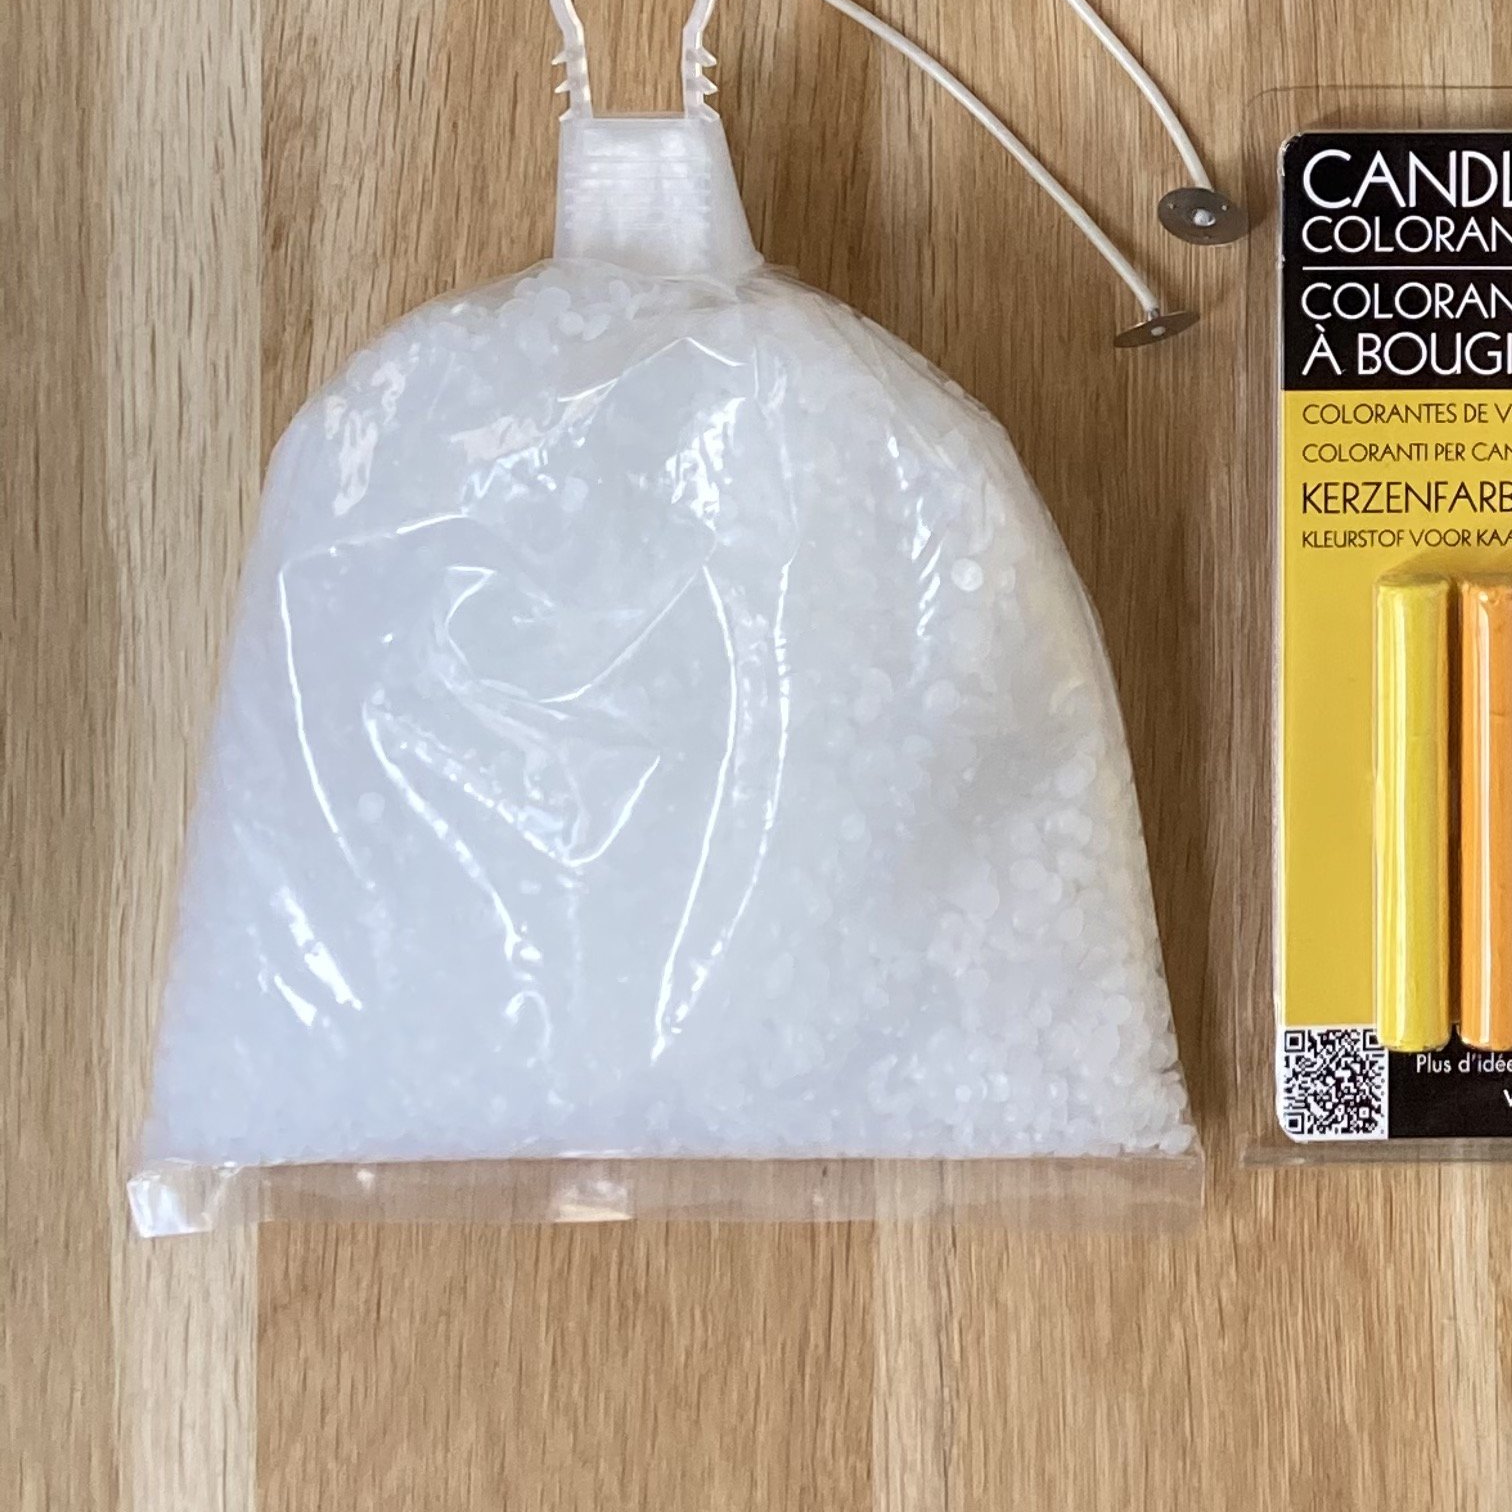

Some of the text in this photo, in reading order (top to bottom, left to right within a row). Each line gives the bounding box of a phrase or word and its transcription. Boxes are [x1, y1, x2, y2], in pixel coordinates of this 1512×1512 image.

[1301, 322, 1342, 376] À
[1302, 403, 1457, 425] COLORANTES
[1463, 403, 1489, 424] DE
[1302, 442, 1428, 463] COLORANTI
[1434, 442, 1465, 462] PER
[1302, 529, 1405, 549] KLEURSTOF
[1409, 528, 1472, 548] VOOR
[1416, 1052, 1452, 1074] Plus
